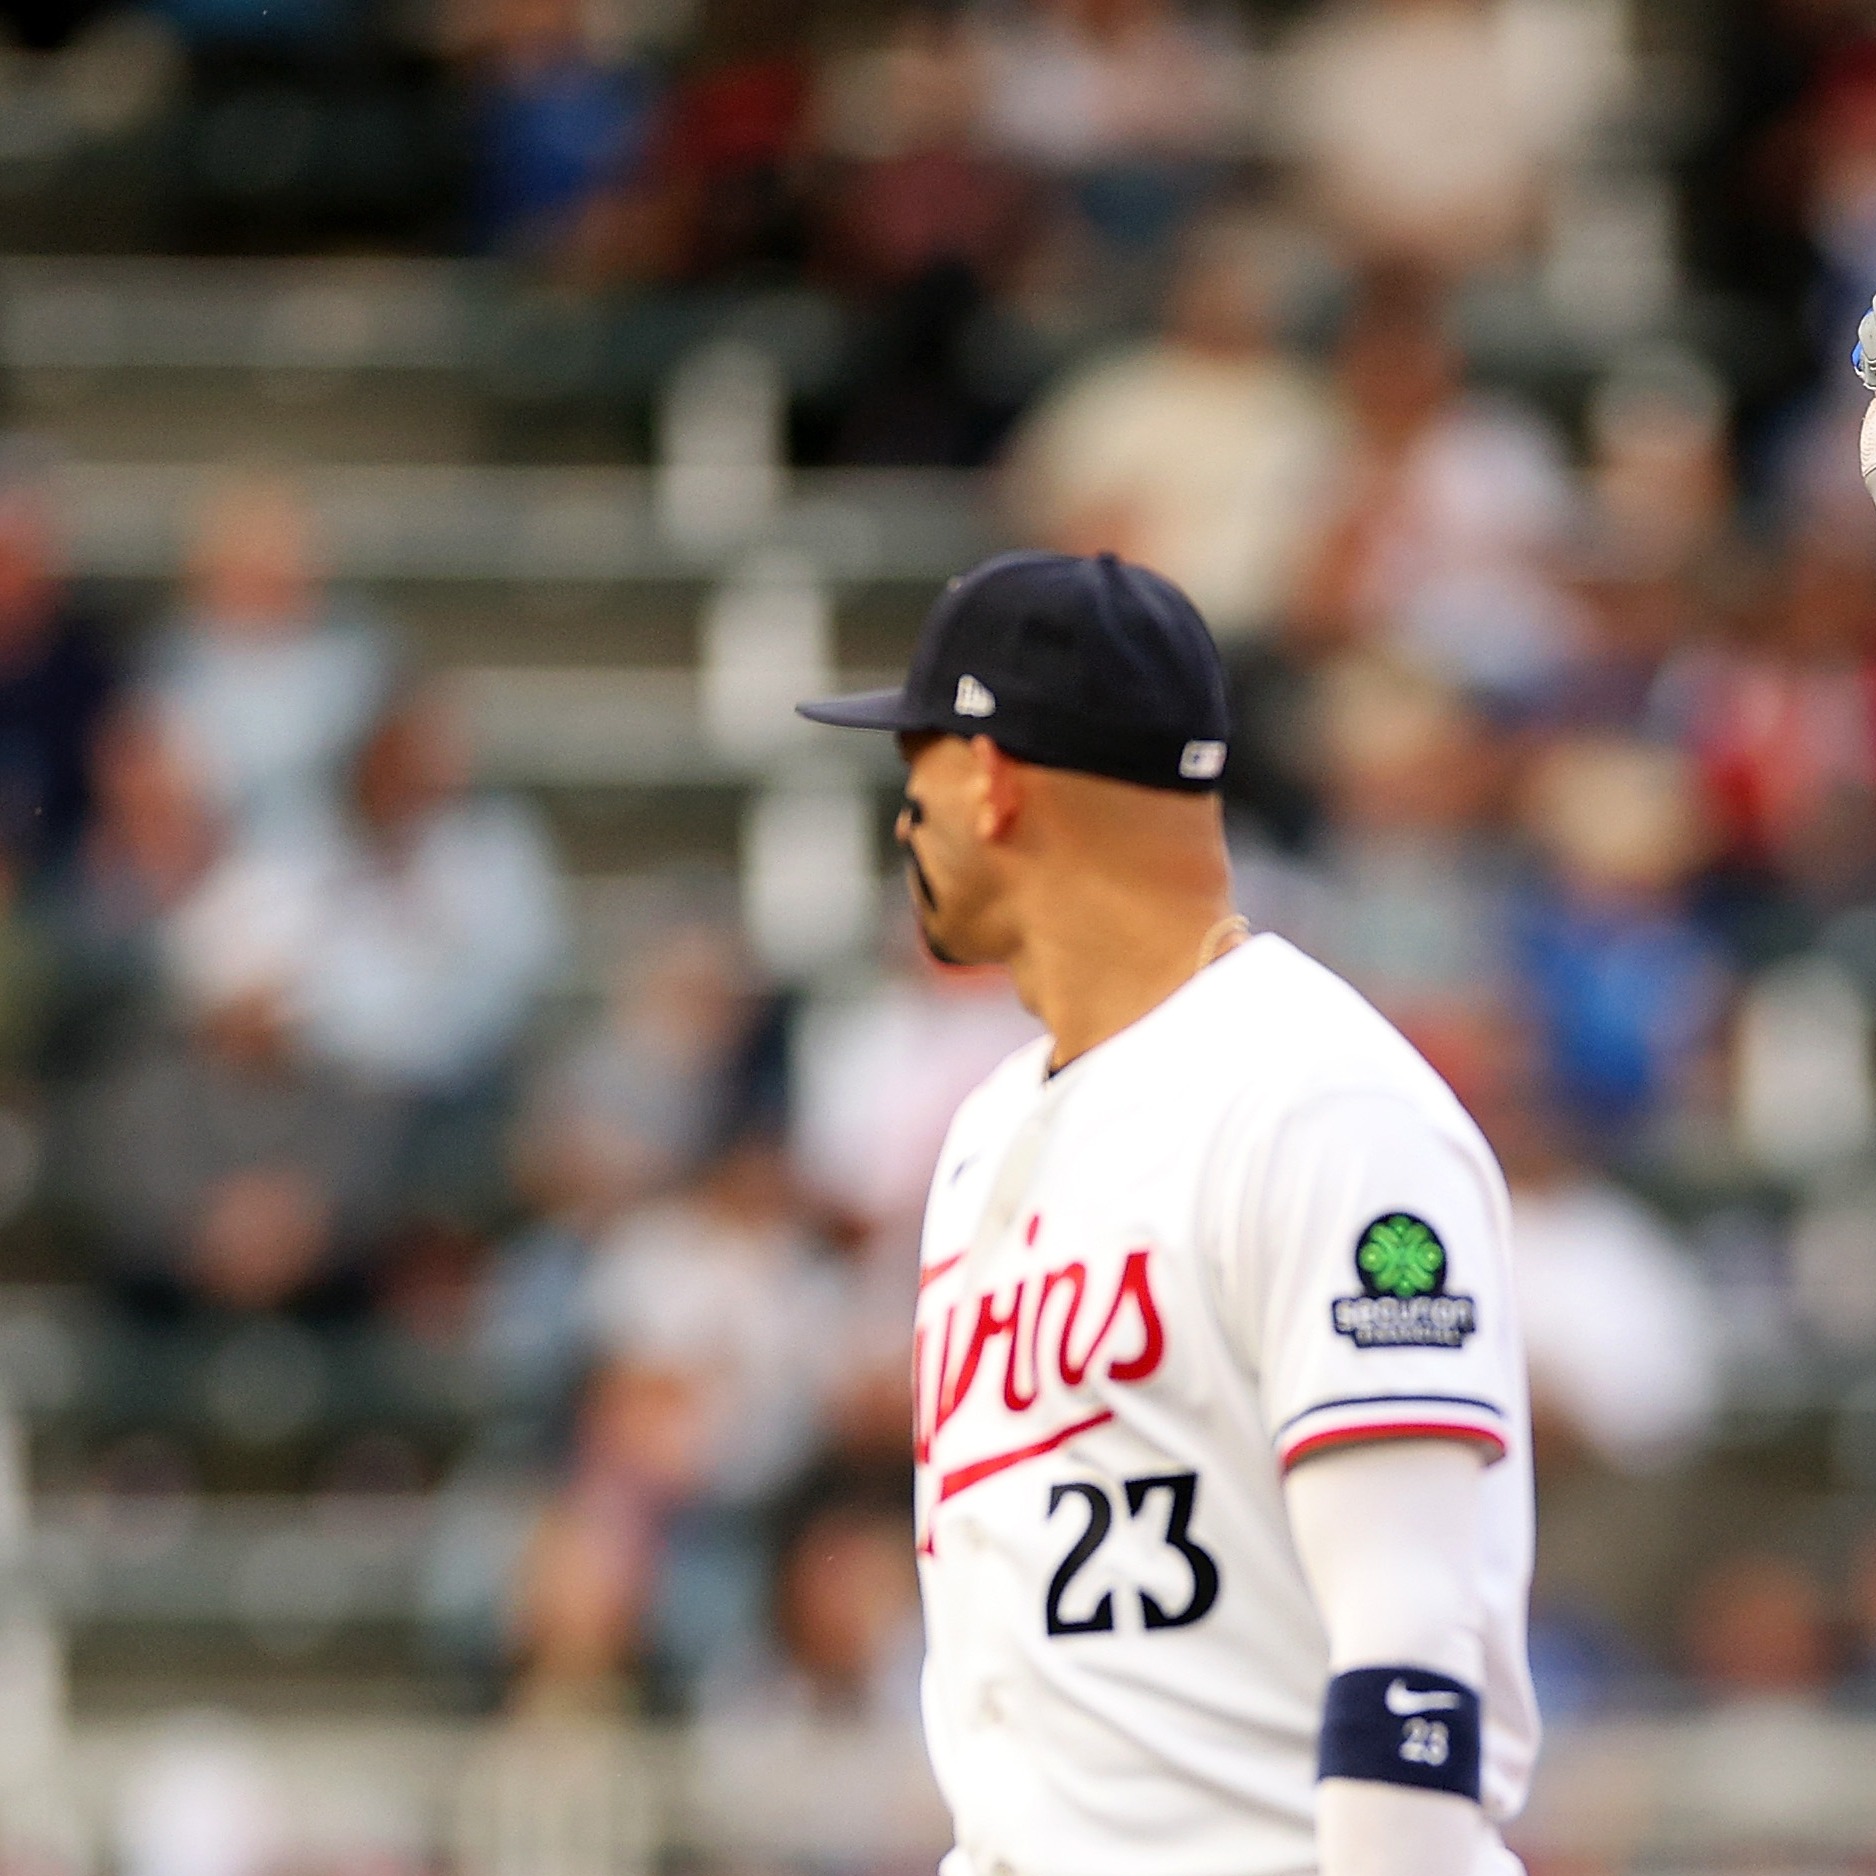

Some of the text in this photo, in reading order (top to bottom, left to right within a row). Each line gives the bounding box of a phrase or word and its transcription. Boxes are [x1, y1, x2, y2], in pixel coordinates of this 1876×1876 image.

[914, 1213, 1166, 1465] wins
[1046, 1473, 1220, 1636] 23
[1400, 1716, 1450, 1766] 23
